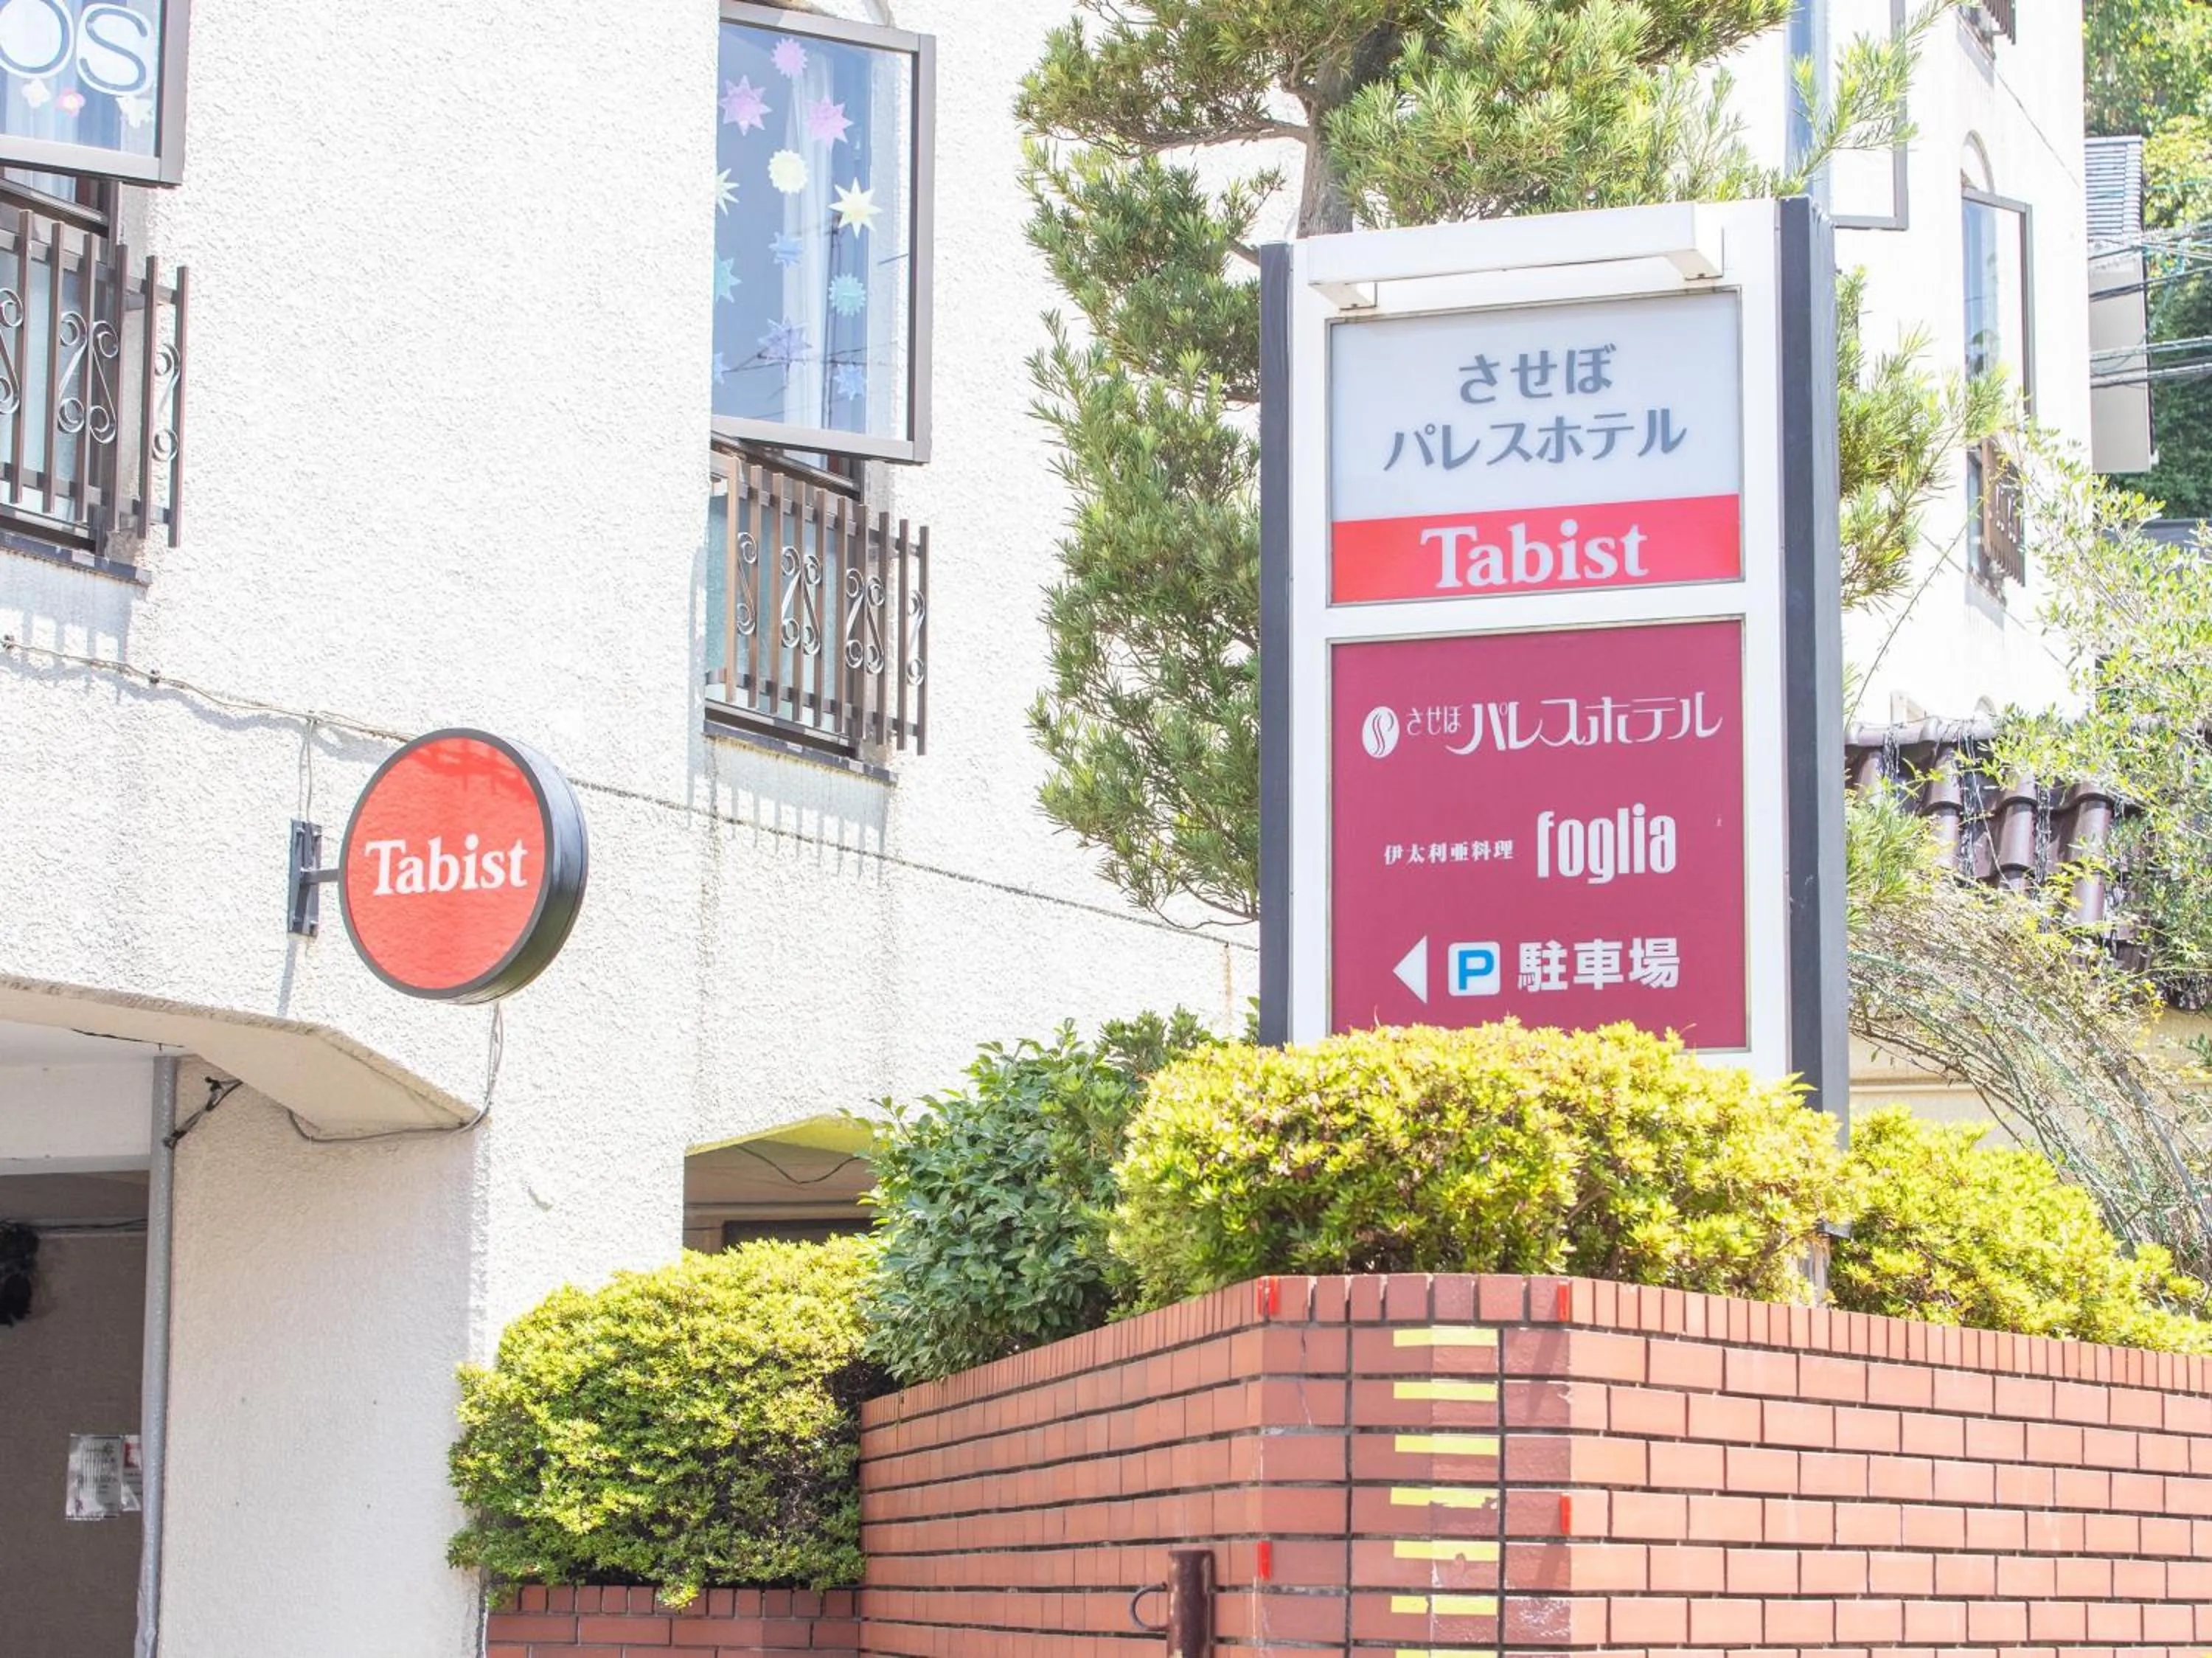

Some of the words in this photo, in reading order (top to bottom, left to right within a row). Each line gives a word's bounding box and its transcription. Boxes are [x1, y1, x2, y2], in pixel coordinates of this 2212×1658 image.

[1458, 343, 1616, 405] させぼ
[1383, 408, 1687, 471] パレスホテル
[1420, 518, 1649, 589] Tabist
[364, 833, 528, 895] Tabist
[1384, 839, 1514, 866] 伊太利亜料理
[1536, 802, 1677, 884] foglia
[1517, 937, 1681, 992] 駐車場
